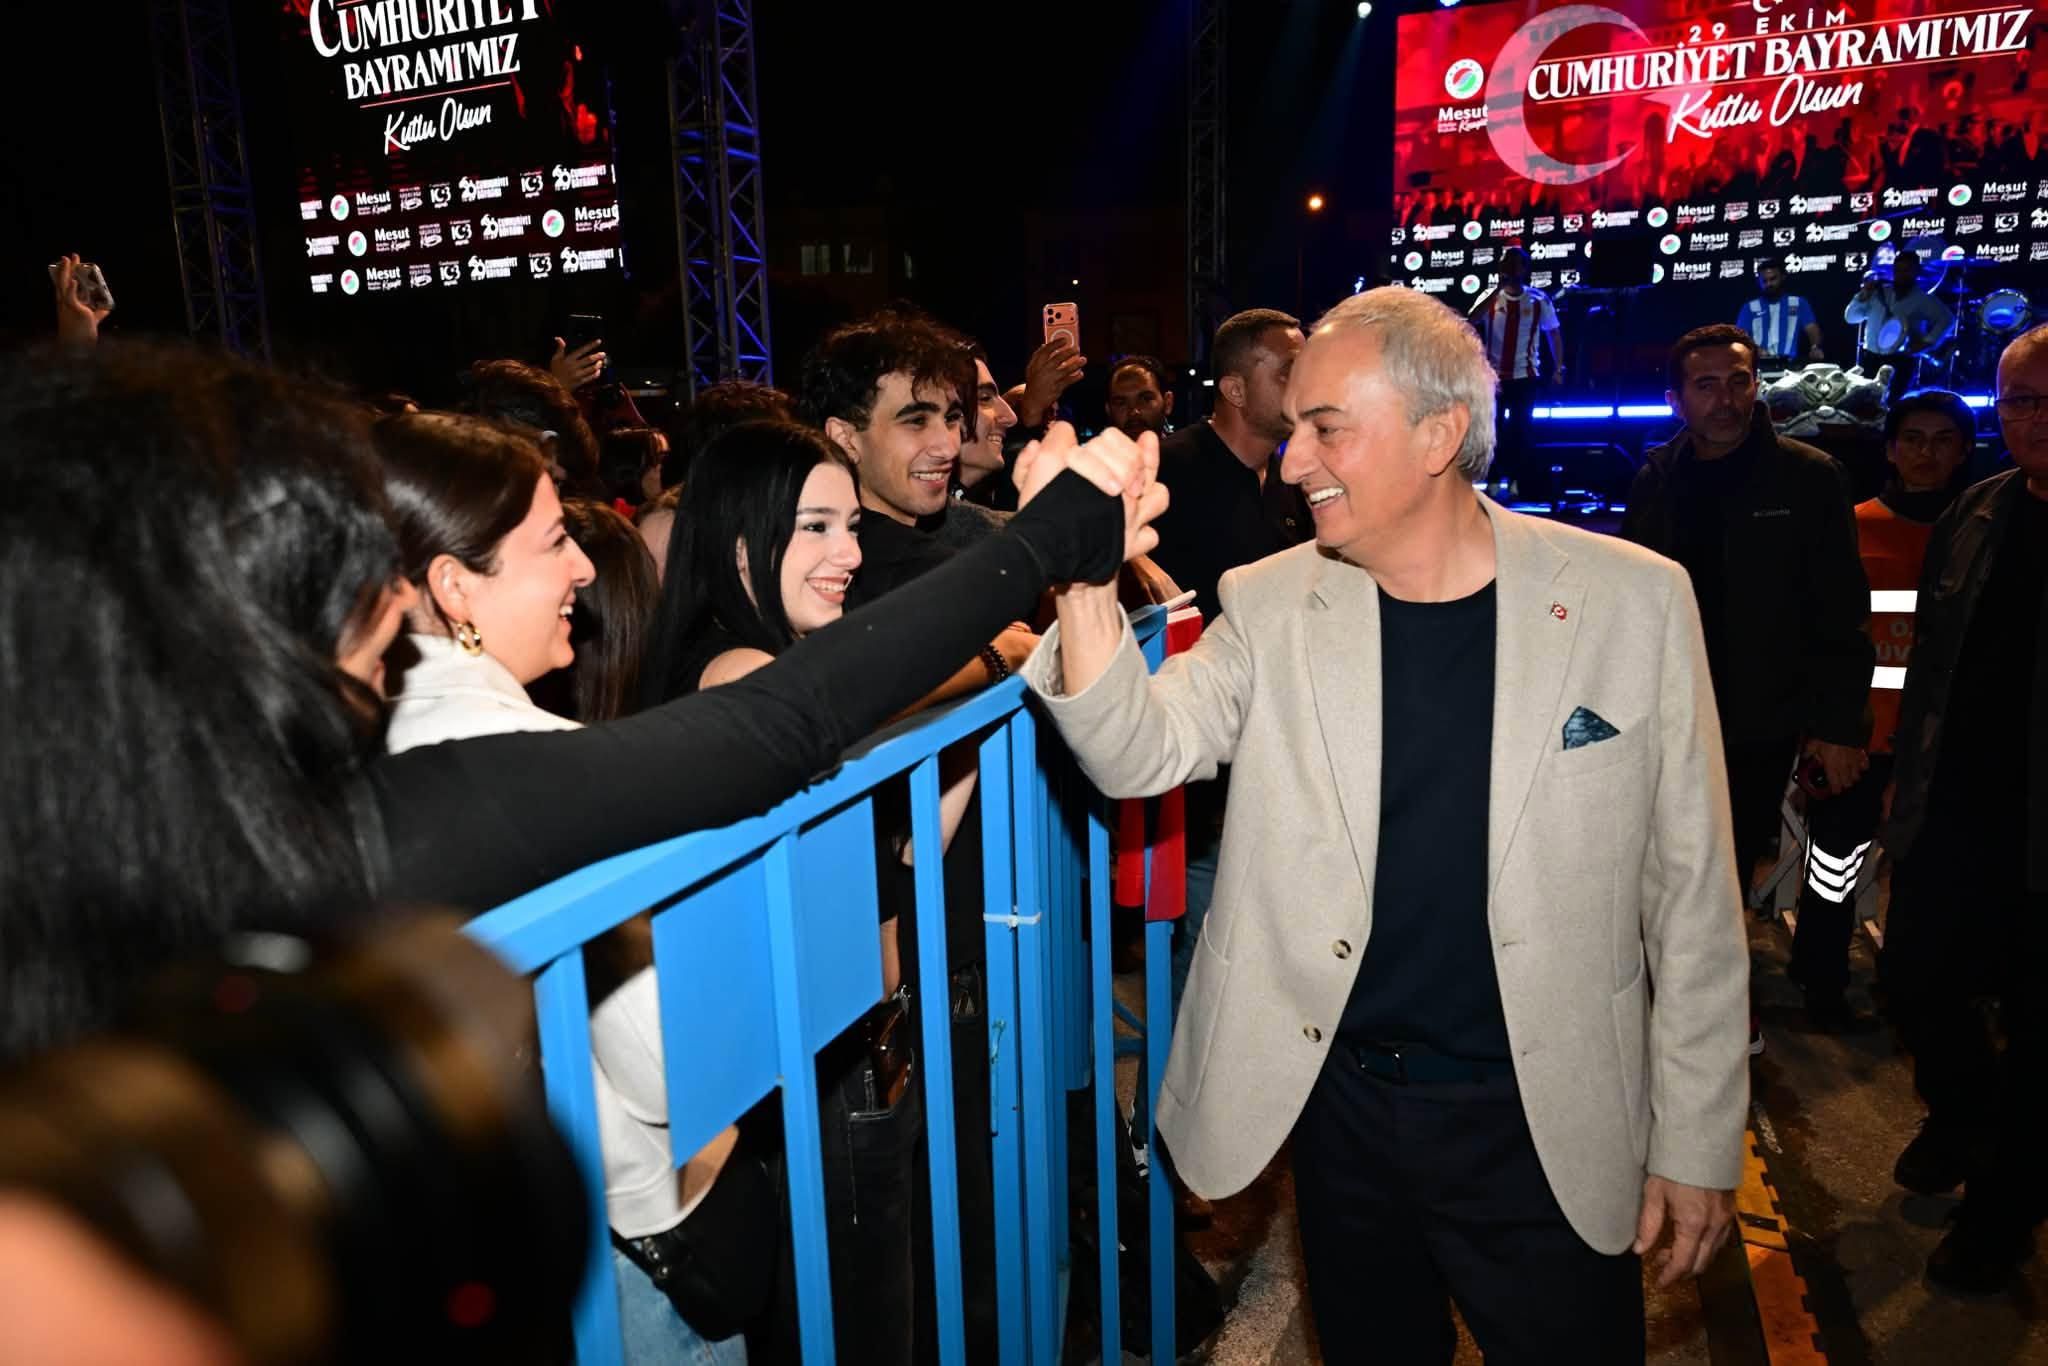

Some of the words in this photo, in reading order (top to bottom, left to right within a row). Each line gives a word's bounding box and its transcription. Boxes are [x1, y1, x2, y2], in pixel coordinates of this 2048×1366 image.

[1689, 22, 1726, 43] 29
[1527, 41, 1756, 101] CUMHURİYET
[1763, 9, 2033, 76] BAYRAMI'MIZ
[344, 33, 520, 100] BAYRAMI'MIZ
[1438, 104, 1488, 121] Mesut
[1667, 90, 1763, 144] Kutlu
[1768, 73, 1864, 127] Olsun
[384, 112, 436, 155] Kutlu
[440, 98, 492, 141] Olsun
[1984, 182, 2027, 196] Mesut
[356, 191, 391, 206] Mesut
[1677, 205, 1715, 220] Mesut
[1490, 219, 1524, 232] Mesut
[1903, 218, 1944, 231] Mesut
[375, 228, 410, 242] Mesut
[1691, 233, 1728, 247] Mesut
[1431, 250, 1464, 264] Mesut
[1976, 244, 2019, 259] Mesut
[366, 267, 401, 281] Mesut
[1674, 262, 1711, 275] Mesut
